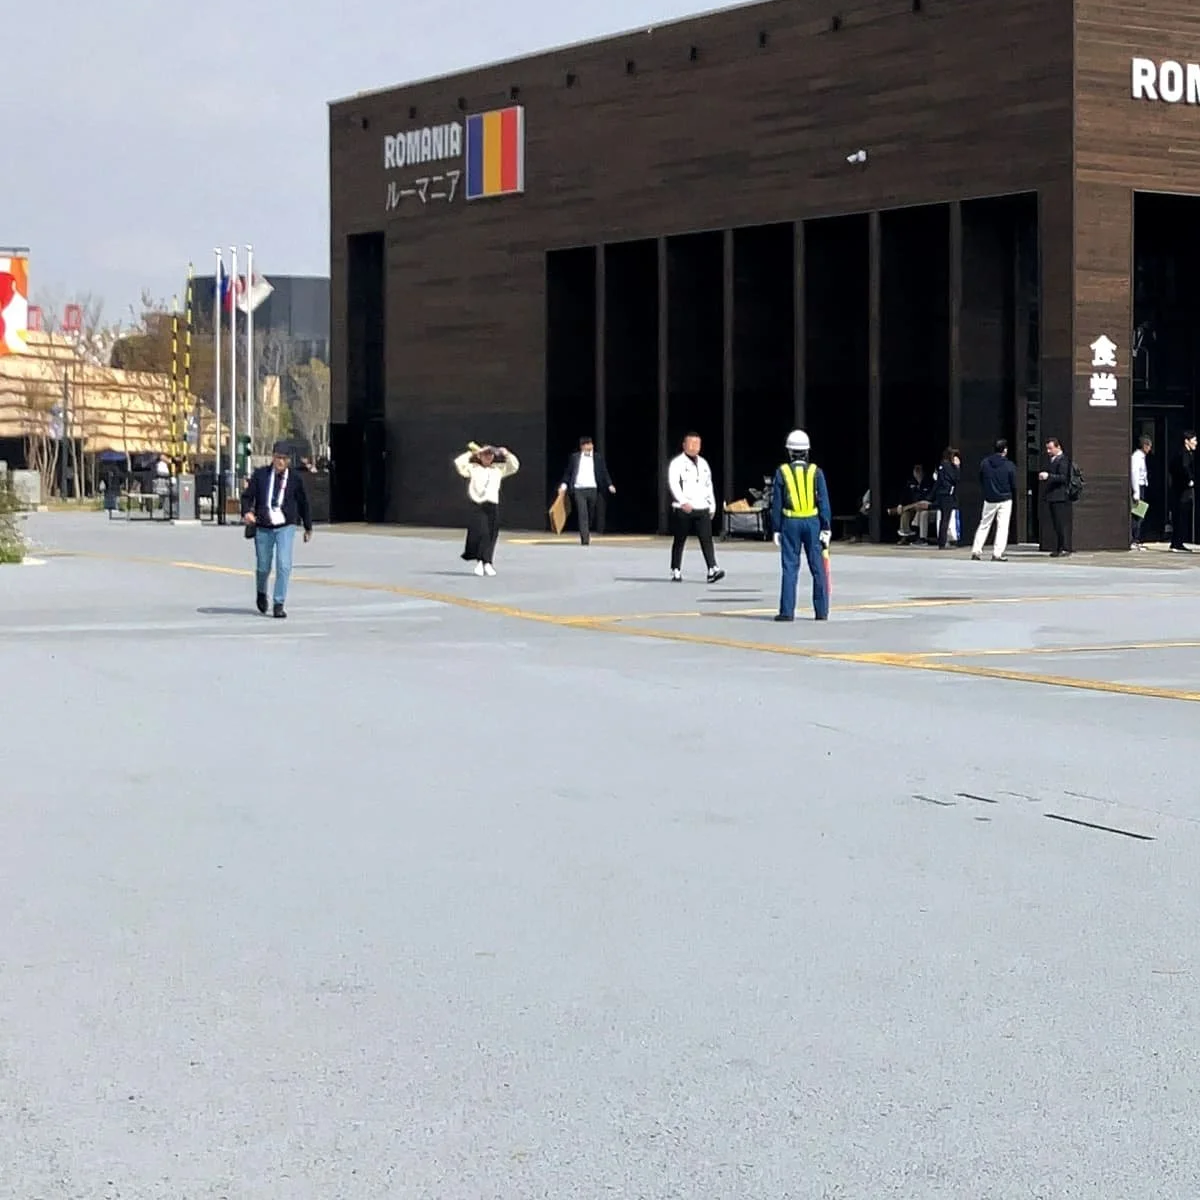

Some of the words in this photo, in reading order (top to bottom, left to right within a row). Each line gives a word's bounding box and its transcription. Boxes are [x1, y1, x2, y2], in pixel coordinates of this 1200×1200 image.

[384, 122, 462, 169] ROMANIA
[385, 170, 461, 211] ルーマニア
[1089, 335, 1117, 406] 食堂
